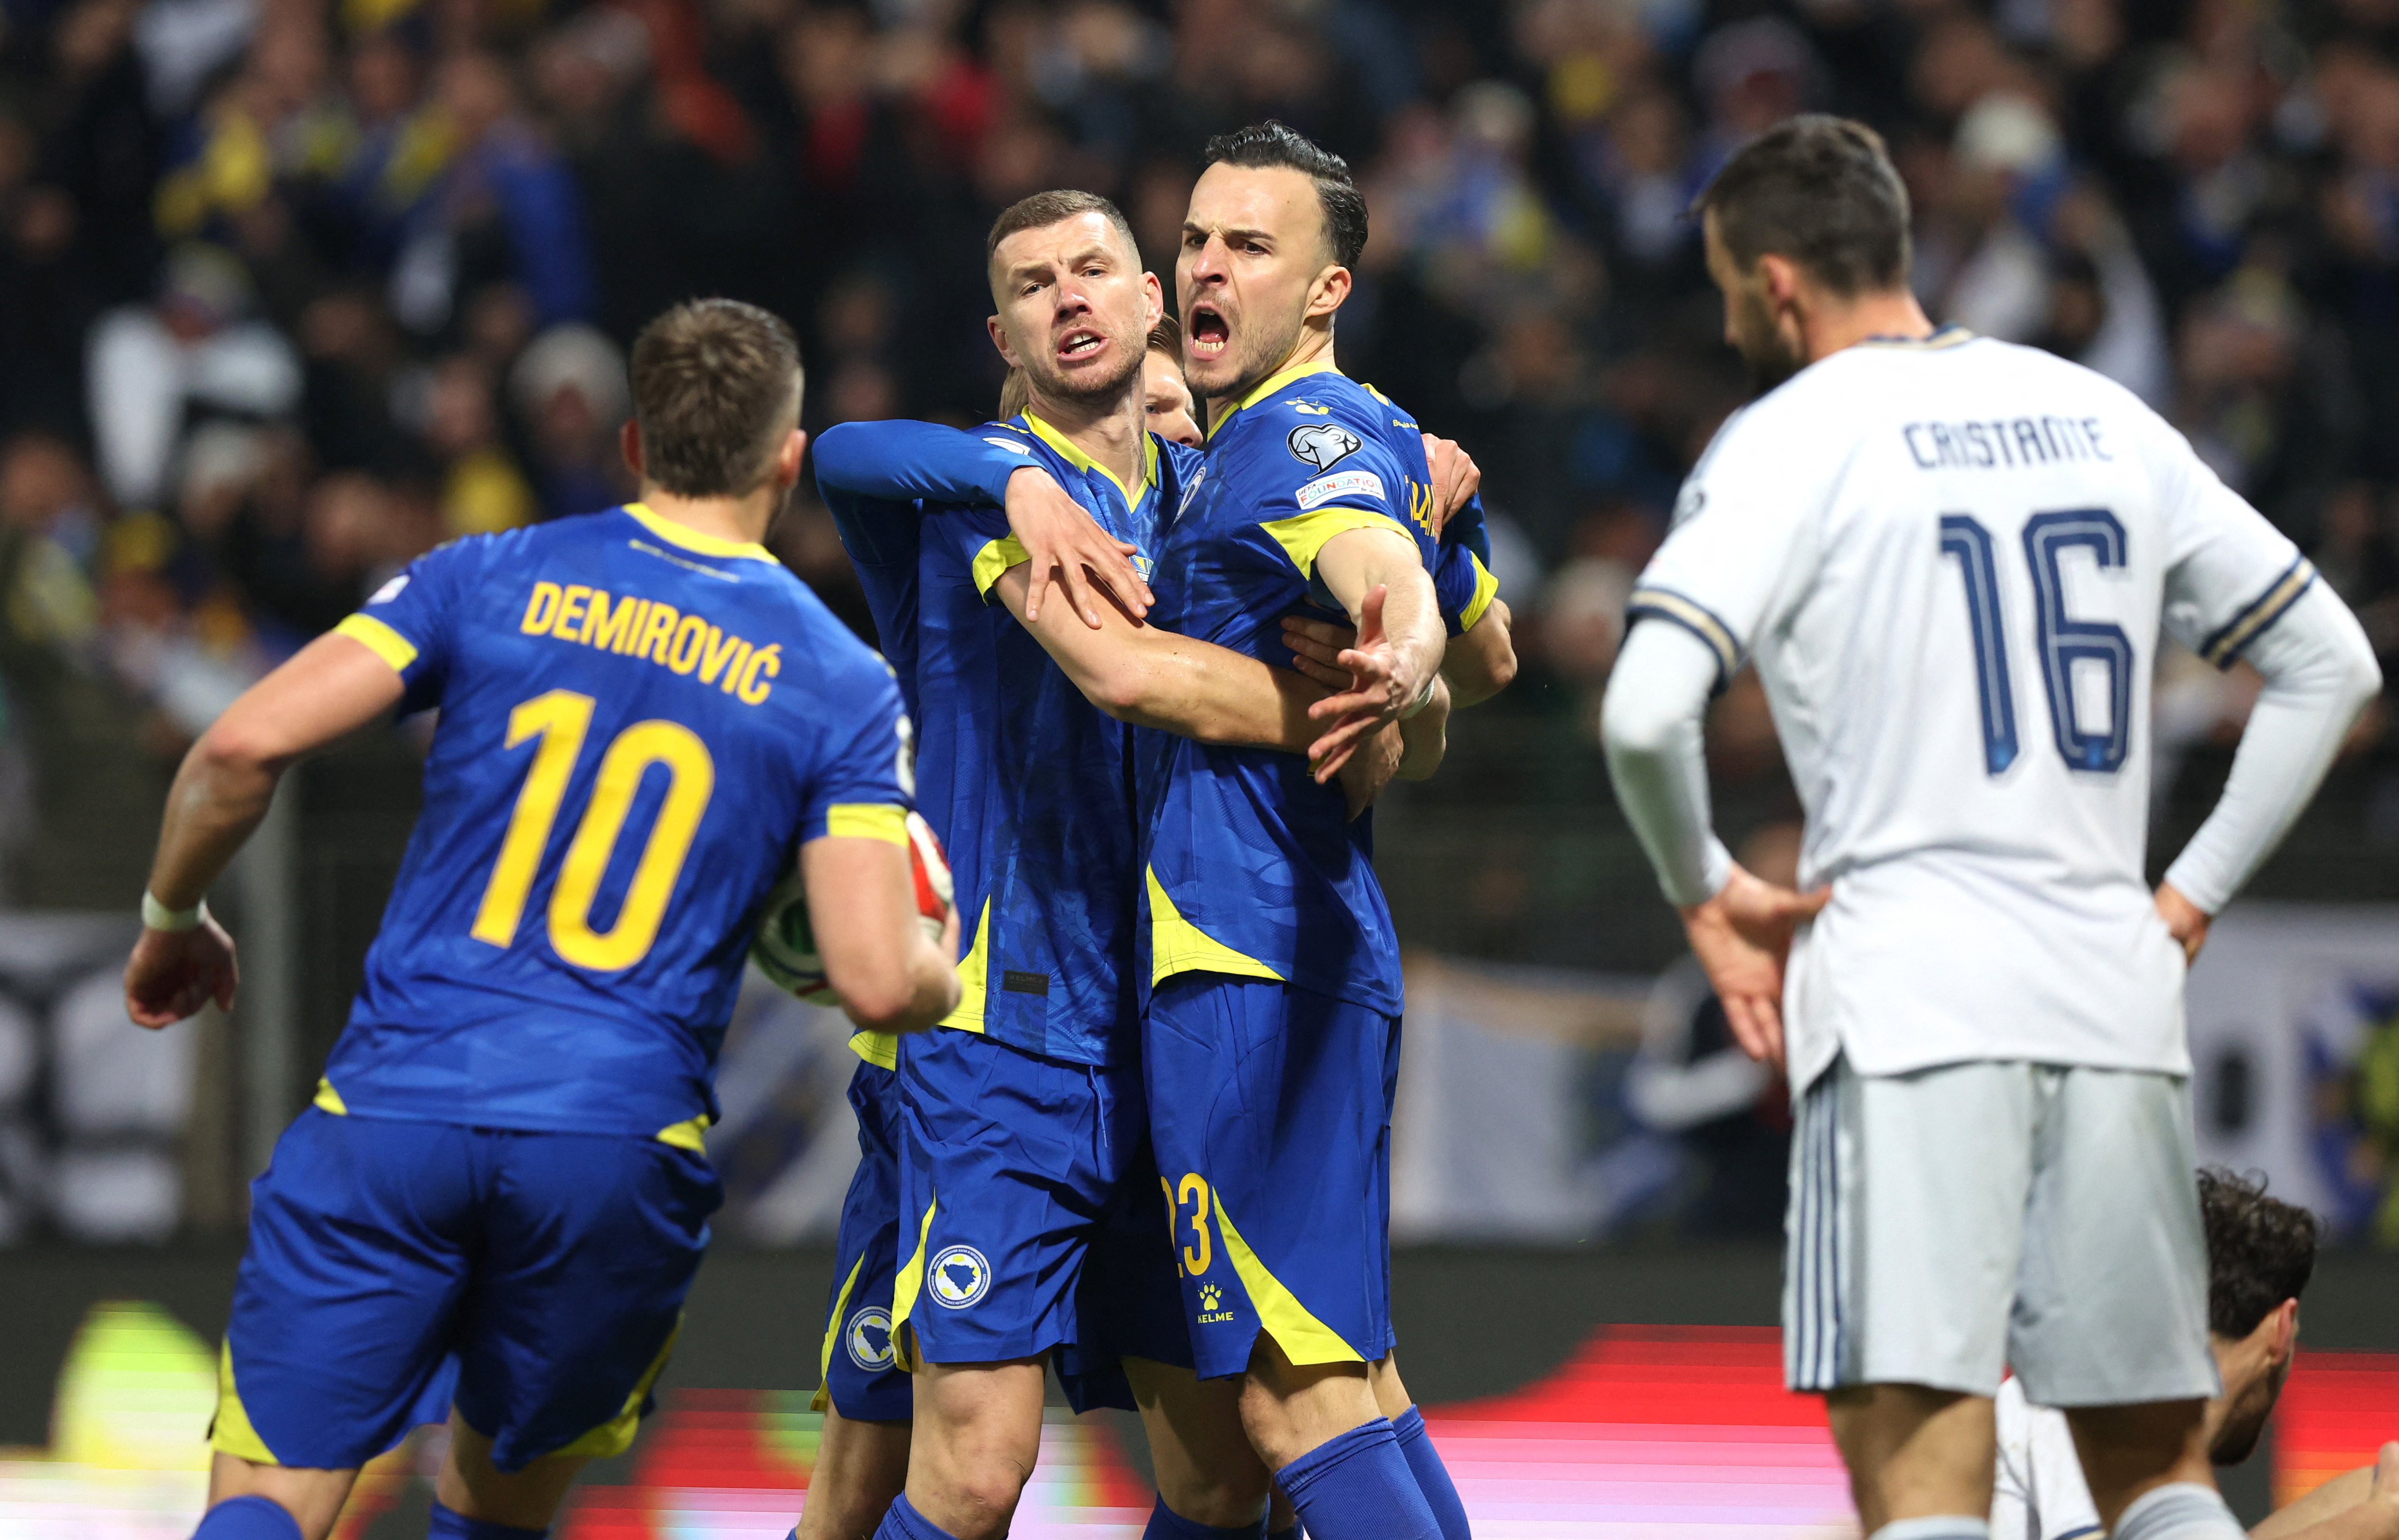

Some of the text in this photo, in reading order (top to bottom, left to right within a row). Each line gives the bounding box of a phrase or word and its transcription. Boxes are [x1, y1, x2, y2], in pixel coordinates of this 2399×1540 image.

[1299, 483, 1316, 496] UEFA
[520, 581, 783, 706] DEMIROVIĆ
[1939, 508, 2135, 775] 16
[470, 688, 715, 971] 10
[1197, 1311, 1234, 1324] KELME
